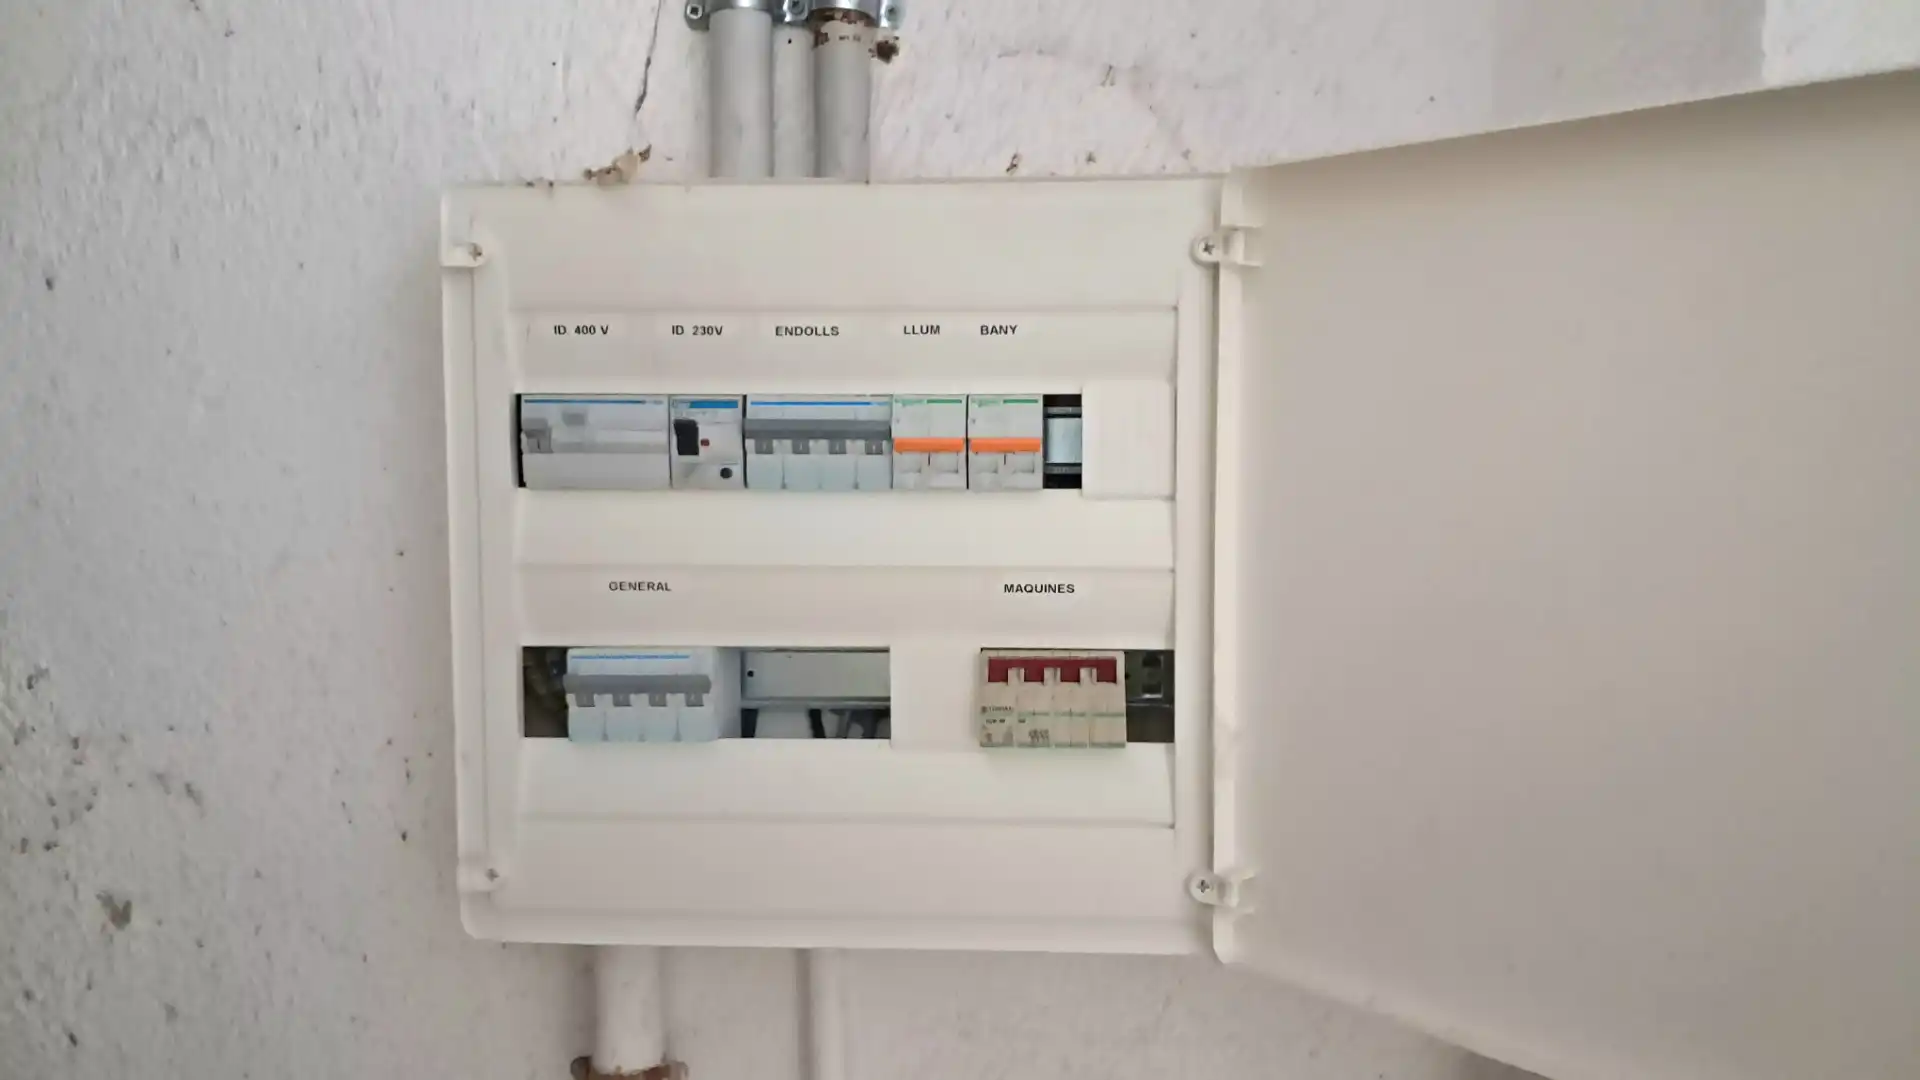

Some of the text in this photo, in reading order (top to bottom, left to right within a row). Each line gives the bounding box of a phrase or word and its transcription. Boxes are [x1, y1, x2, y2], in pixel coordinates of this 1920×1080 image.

[574, 324, 597, 336] 400
[600, 324, 609, 336] V
[671, 324, 723, 336] ID 230V
[775, 325, 840, 337] ENDOLLS
[903, 324, 941, 336] LLUM
[980, 324, 1018, 336] BANY
[608, 581, 671, 592] GENERAL
[1003, 583, 1076, 595] MAQUINES
